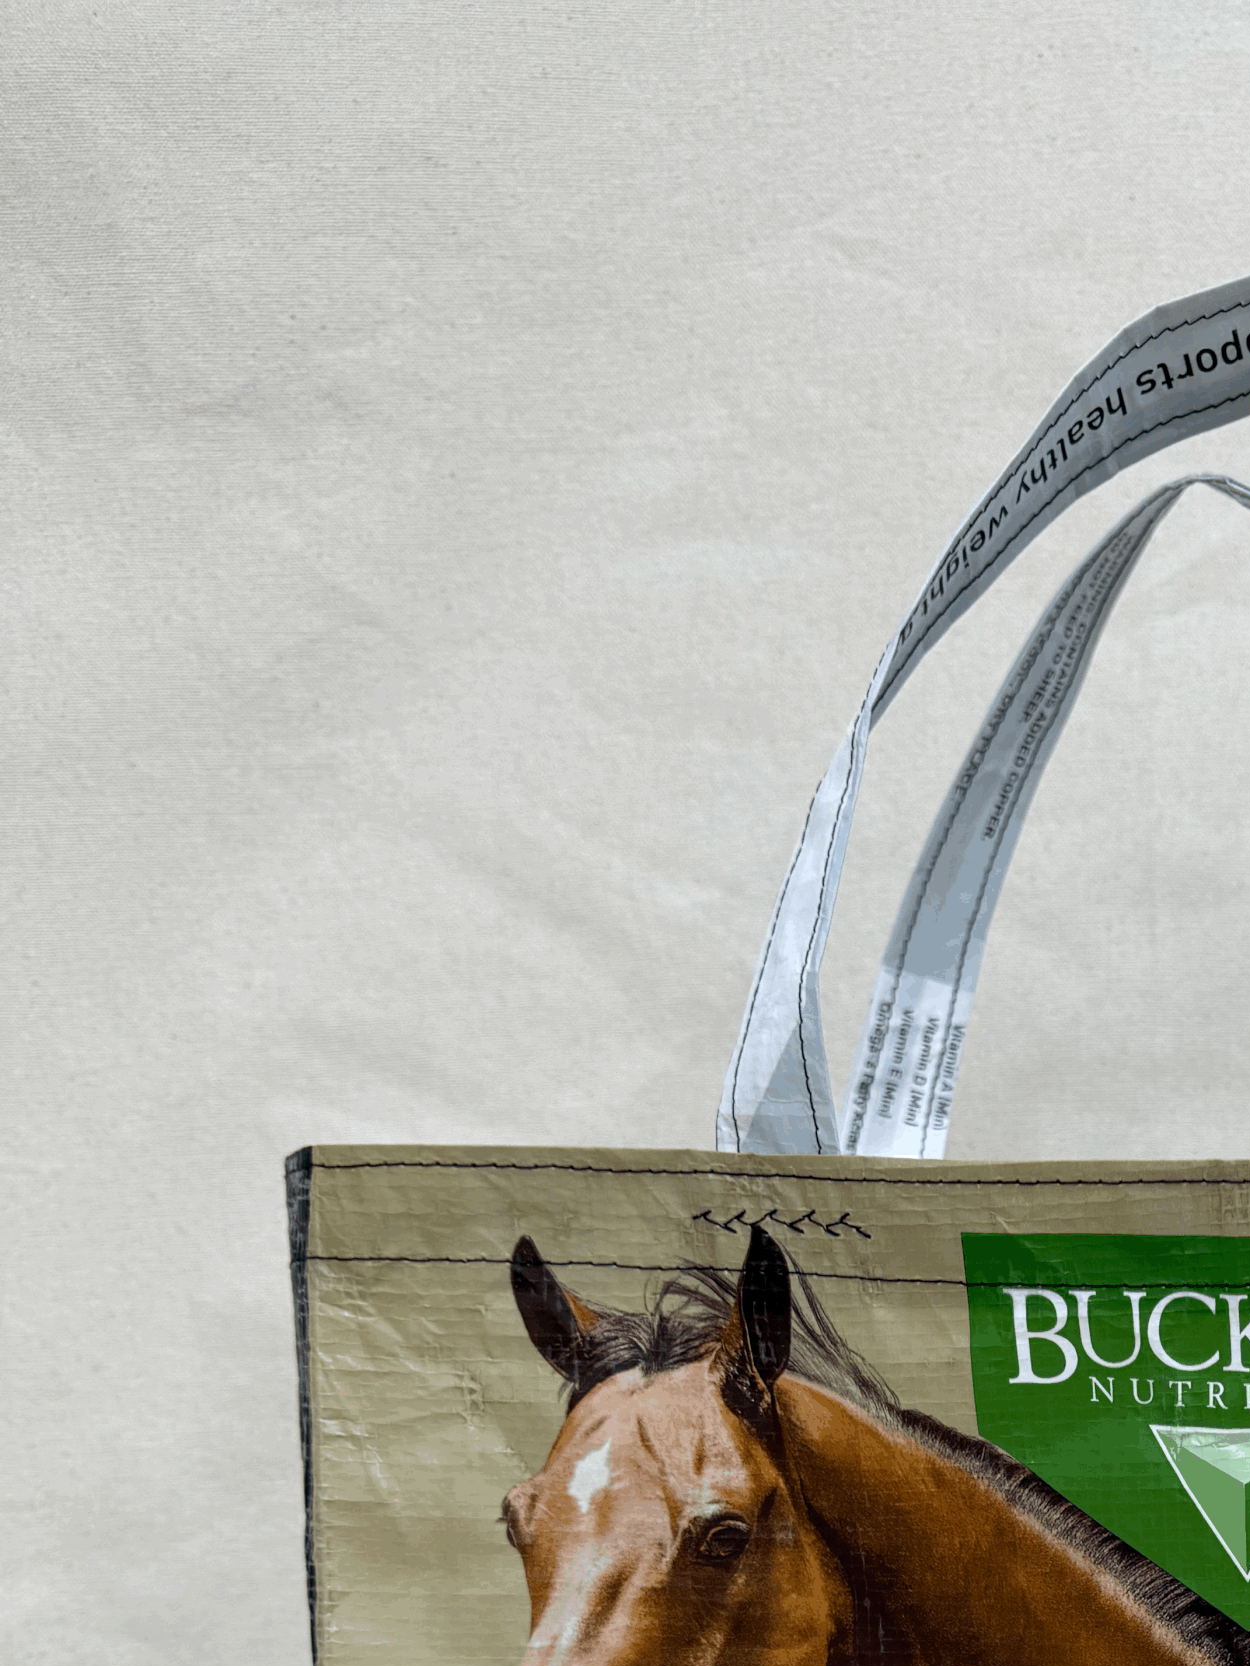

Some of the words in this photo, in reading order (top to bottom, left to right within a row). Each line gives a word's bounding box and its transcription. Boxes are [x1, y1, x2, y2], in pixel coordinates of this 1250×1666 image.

[1015, 387, 1128, 504] healthy
[920, 505, 1009, 616] weight
[1044, 622, 1087, 708] CONTAINS
[1014, 709, 1048, 768] ADDED
[893, 1008, 915, 1065] Vitamin
[916, 1016, 939, 1071] Vitamin
[942, 1023, 966, 1078] Vitamin
[889, 1068, 903, 1079] E
[912, 1074, 928, 1086] D
[940, 1082, 953, 1092] A
